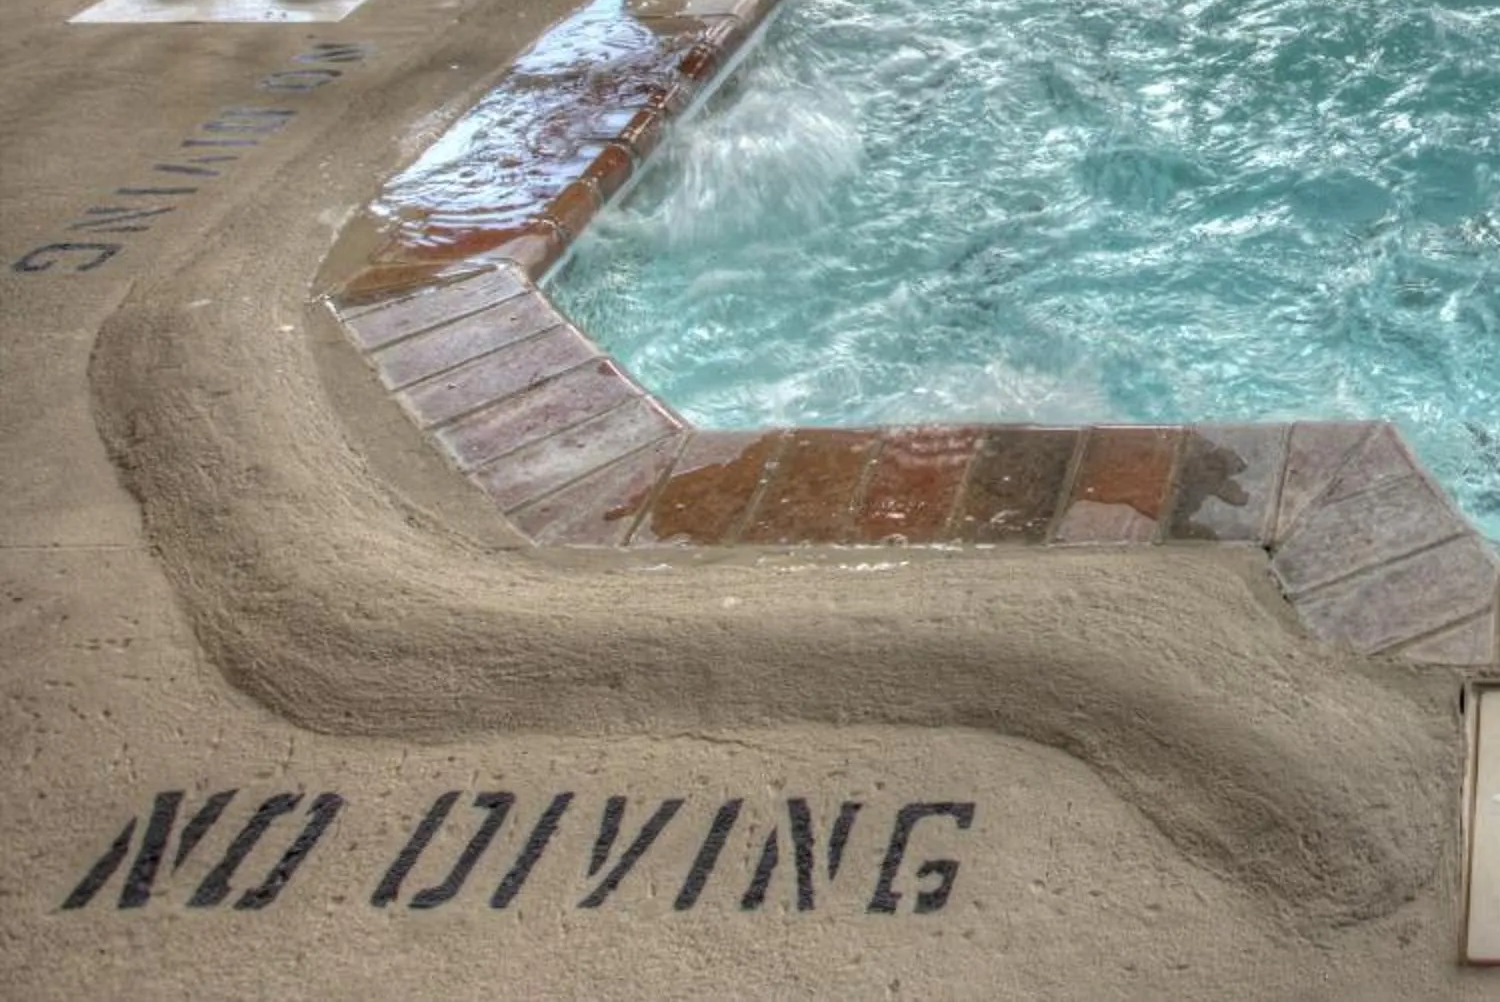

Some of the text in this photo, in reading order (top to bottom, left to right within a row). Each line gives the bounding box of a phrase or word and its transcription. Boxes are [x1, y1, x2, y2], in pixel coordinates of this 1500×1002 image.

[12, 108, 297, 273] DIVING
[60, 791, 977, 915] NO DIVING
